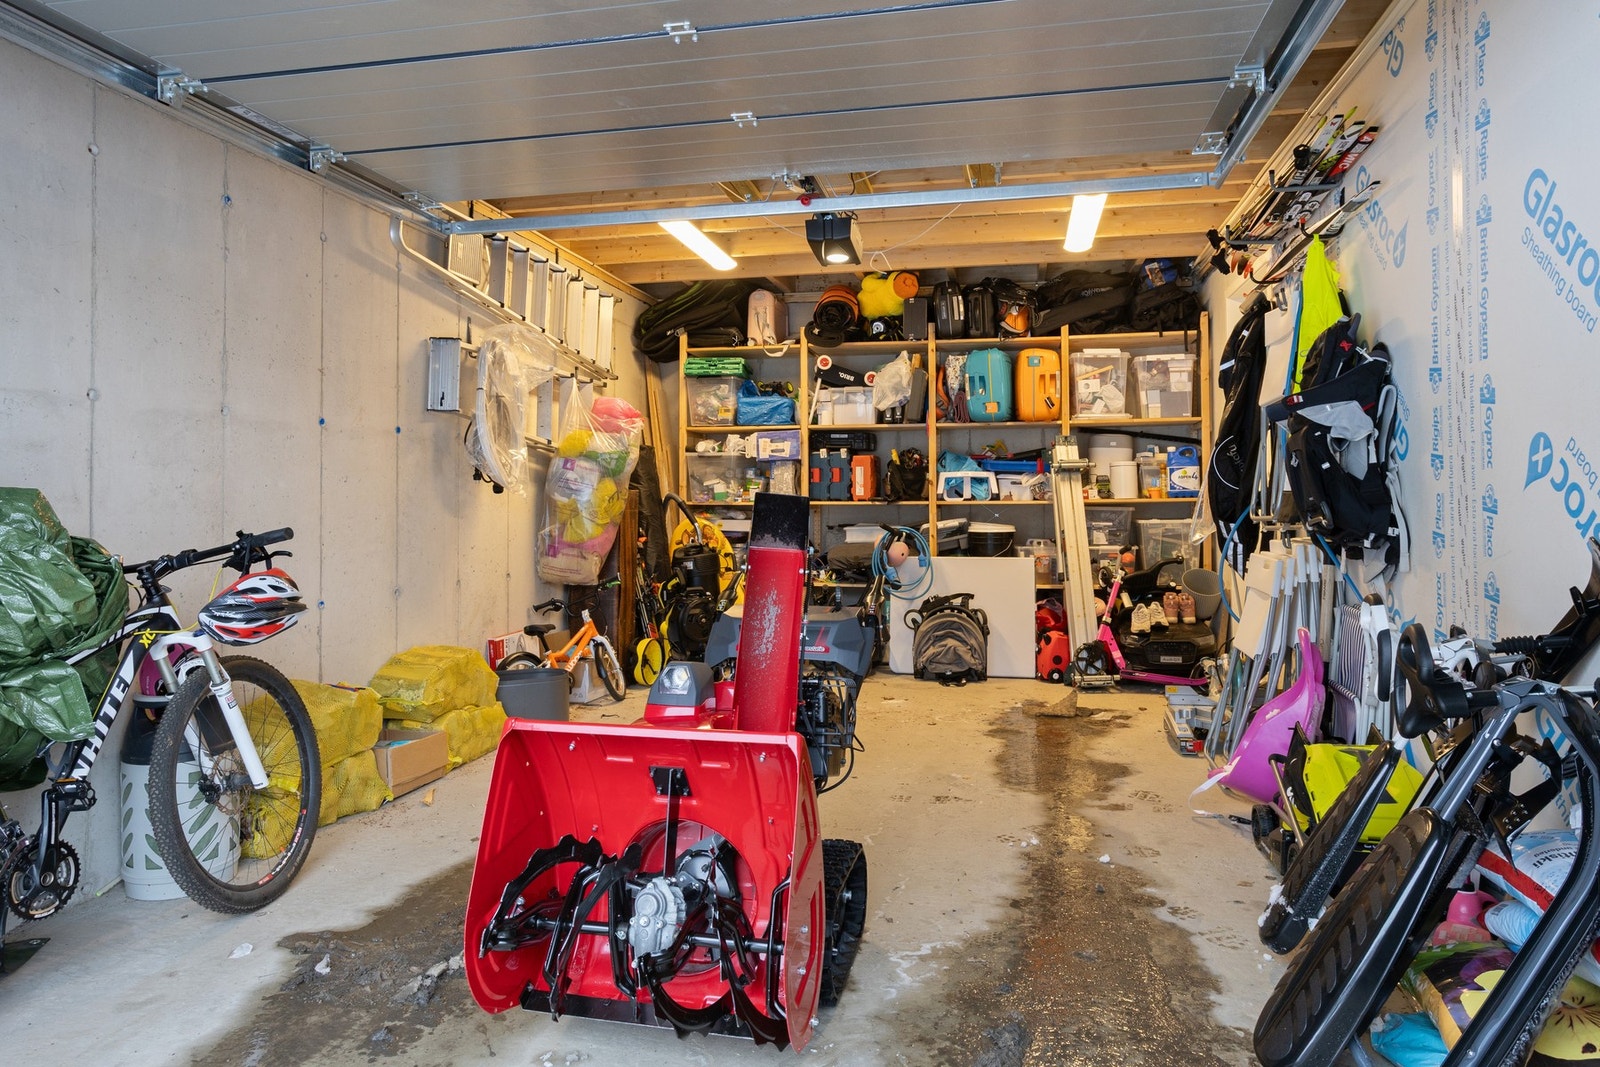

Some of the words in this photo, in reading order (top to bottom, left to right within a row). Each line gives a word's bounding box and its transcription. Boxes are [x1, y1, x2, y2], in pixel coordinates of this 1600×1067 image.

[1427, 0, 1435, 35] Rigip
[1479, 43, 1487, 87] Placo
[1428, 152, 1436, 206] Gyproc
[1479, 129, 1489, 181] Rigips
[1356, 165, 1395, 254] Glsroc
[1431, 248, 1439, 312] Gypsum
[1480, 227, 1489, 283] British
[1521, 227, 1566, 296] Sheathing
[1565, 284, 1598, 333] board
[1480, 287, 1489, 360] Gypsum
[1432, 407, 1440, 451] Rigips
[1484, 406, 1494, 469] Gyproc
[1566, 437, 1598, 490] board
[1486, 515, 1494, 557] Placo
[1436, 571, 1444, 628] Gyproc
[1489, 604, 1499, 641] Rigip
[1532, 850, 1577, 868] ntiskli
